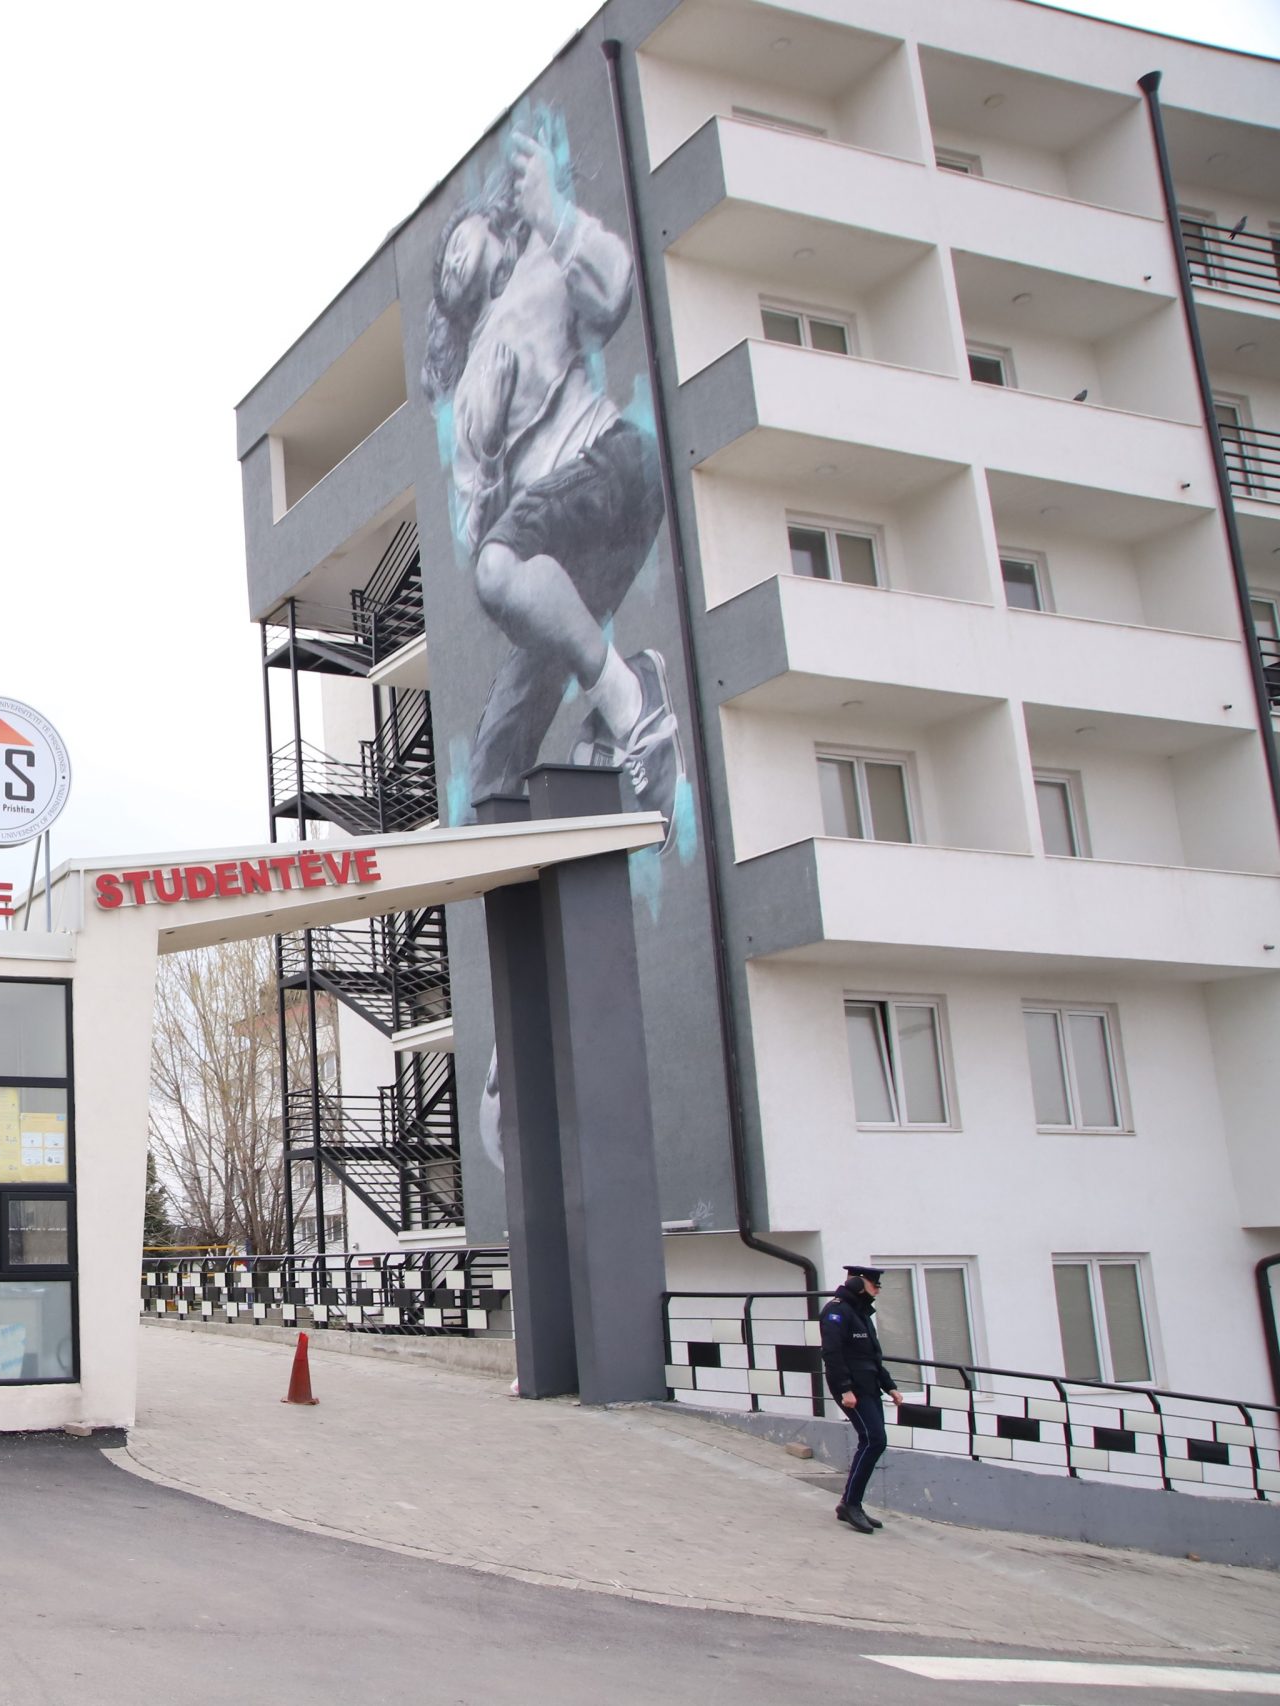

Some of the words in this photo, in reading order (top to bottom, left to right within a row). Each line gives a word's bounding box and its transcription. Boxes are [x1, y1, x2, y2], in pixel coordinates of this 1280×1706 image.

[2, 803, 35, 814] Prishtina
[1, 823, 41, 839] UNIVERSITY
[95, 848, 382, 909] STUDENTËVE
